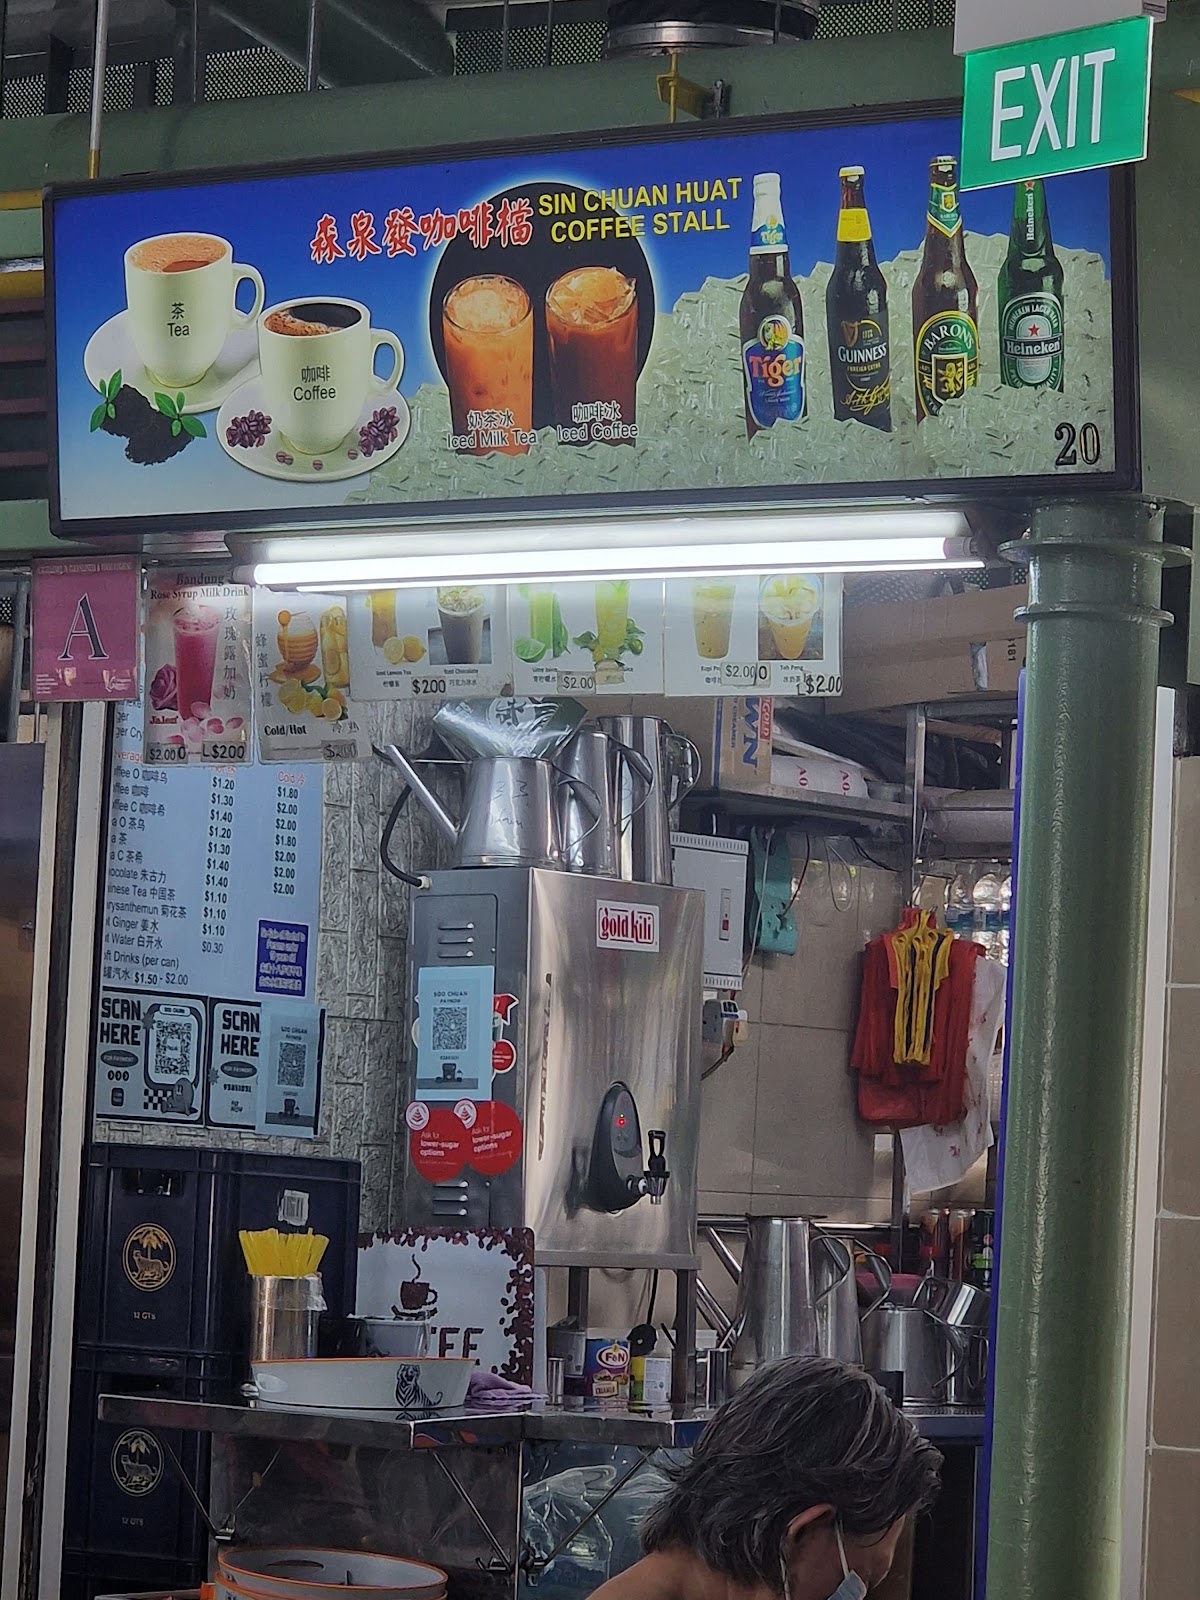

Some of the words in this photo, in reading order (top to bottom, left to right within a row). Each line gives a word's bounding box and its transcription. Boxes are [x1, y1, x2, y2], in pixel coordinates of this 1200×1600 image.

[990, 47, 1116, 162] EXIT
[537, 192, 576, 216] SIN
[584, 187, 668, 212] CHUAN
[676, 178, 742, 204] HUAT
[1025, 192, 1035, 242] Heineken
[310, 198, 534, 265] 森泉發咖啡檔
[551, 215, 644, 243] COFFEE
[653, 209, 730, 235] STALL
[171, 302, 185, 320] 茶
[167, 323, 190, 337] Tea
[838, 343, 887, 363] GUINNESS
[1006, 338, 1061, 356] Heineken
[301, 364, 331, 383] 咖啡
[749, 354, 802, 388] Tiger
[293, 386, 336, 401] Coffee
[572, 401, 620, 423] 咖啡冰
[467, 409, 515, 432] 奶茶冰
[447, 432, 476, 450] Iced
[480, 431, 508, 448] Milk
[512, 429, 538, 446] Tea
[557, 426, 587, 442] Iced
[590, 422, 639, 440] Coffee
[1054, 422, 1101, 466] 20
[176, 573, 225, 587] Bandung
[150, 588, 170, 600] Rose
[172, 590, 198, 602] Syrup
[200, 587, 220, 598] Milk
[223, 586, 249, 597] Drink
[57, 592, 109, 660] A
[223, 606, 238, 700] 玫瑰露加奶
[725, 664, 756, 678] $2.00
[563, 676, 594, 689] $2.00
[130, 726, 143, 742] Cry
[264, 724, 307, 736] Cold/Hot
[742, 698, 760, 768] WN
[149, 748, 176, 761] $2.00
[132, 768, 140, 779] O
[212, 776, 235, 791] $1.20
[211, 792, 234, 807] $1.30
[277, 786, 299, 800] $1.80
[130, 801, 138, 813] C
[277, 802, 298, 816] $2.00
[119, 816, 127, 828] O
[210, 808, 233, 823] $1.40
[209, 825, 232, 839] $1.20
[275, 818, 297, 831] $2.00
[275, 834, 297, 847] $1.80
[117, 849, 124, 861] C
[208, 841, 231, 856] $1.30
[207, 857, 230, 872] $1.40
[274, 850, 296, 864] $2.00
[140, 868, 167, 884] 朱古力
[273, 866, 295, 879] $2.00
[206, 874, 229, 888] $1.40
[273, 882, 295, 895] $2.00
[132, 884, 147, 898] Tea
[149, 886, 176, 902] 中国茶
[204, 890, 228, 904] $1.10
[160, 904, 187, 919] 菊花茶
[203, 906, 227, 920] $1.10
[112, 916, 139, 932] Ginger
[202, 923, 225, 937] $1.10
[601, 907, 629, 938] gold
[630, 909, 652, 942] kili
[112, 933, 136, 946] Water
[137, 934, 163, 950] 白开水
[201, 941, 224, 955] $0.30
[113, 950, 140, 964] Drinks
[142, 953, 159, 968] (per
[160, 957, 179, 971] can)
[134, 971, 158, 985] $1.50
[165, 974, 189, 986] $2.00
[101, 997, 141, 1021] SCAN
[222, 1009, 260, 1033] SCAN
[100, 1021, 141, 1046] HERE
[220, 1033, 260, 1058] HERE
[420, 1139, 460, 1149] lower-sugar
[471, 1129, 513, 1144] lower-sugar
[419, 1148, 445, 1157] options
[473, 1142, 499, 1153] options
[605, 1351, 626, 1363] F&N
